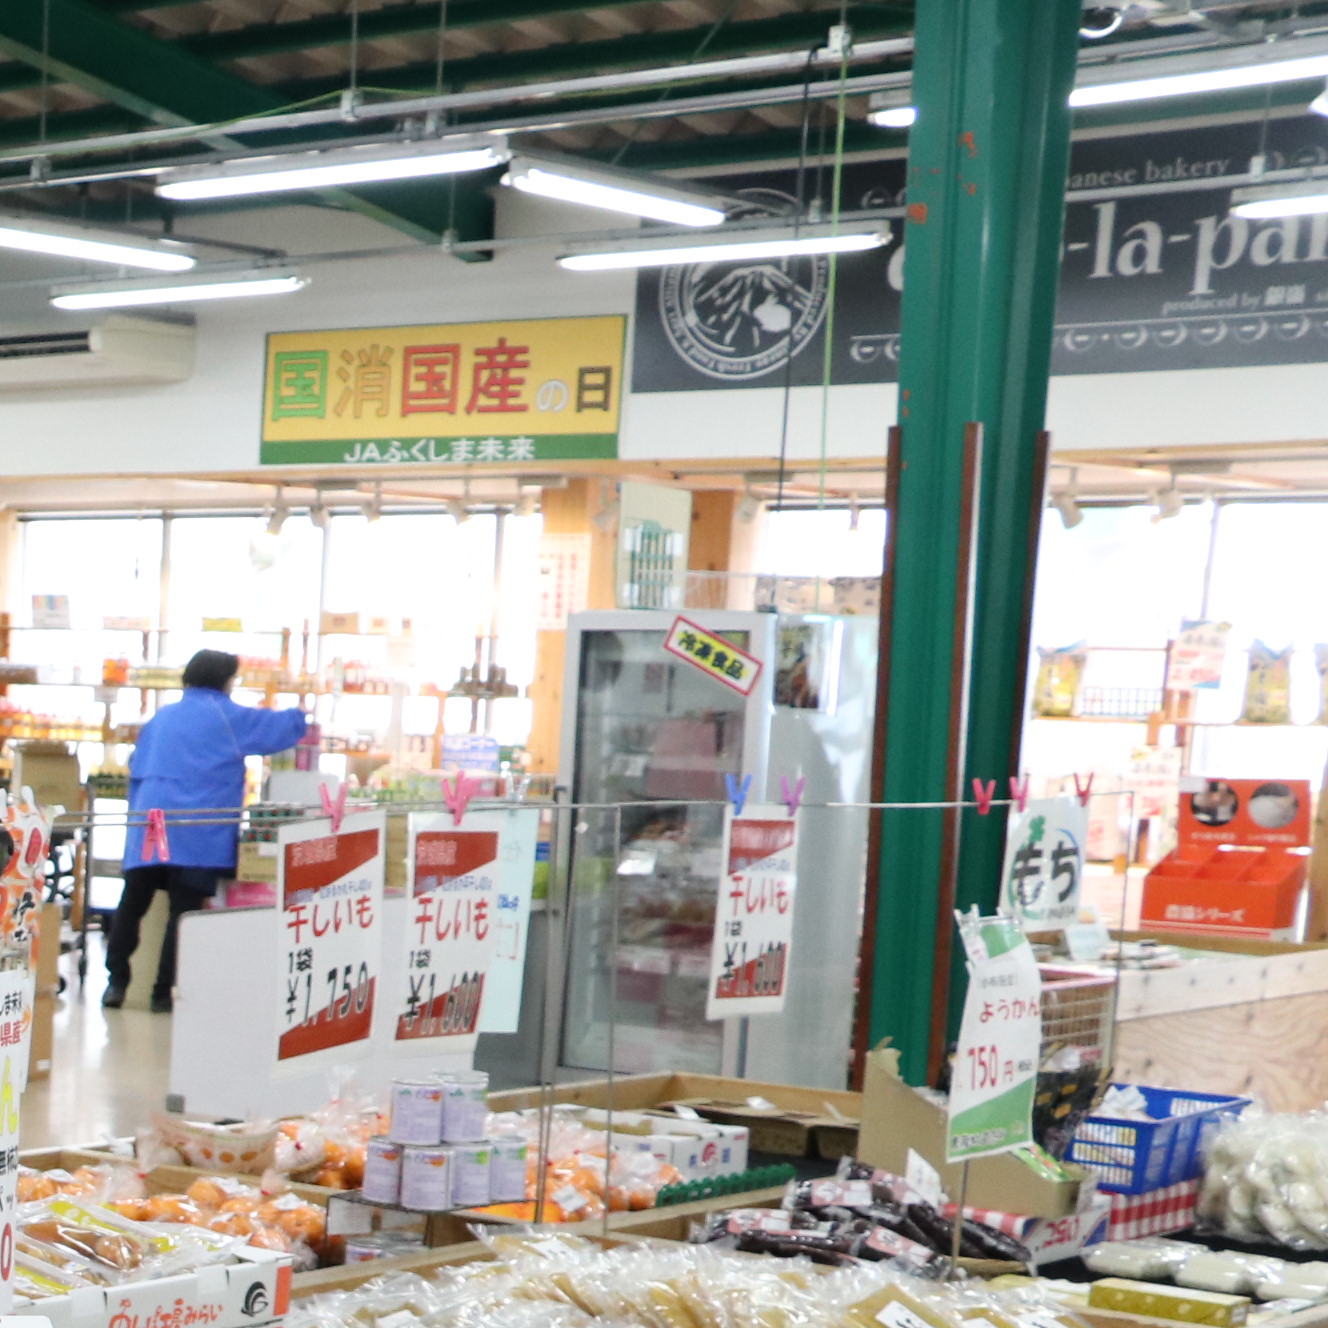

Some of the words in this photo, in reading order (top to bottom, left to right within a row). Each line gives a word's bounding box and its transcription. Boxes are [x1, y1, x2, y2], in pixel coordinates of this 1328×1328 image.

[1145, 157, 1232, 186] bakery
[1161, 297, 1237, 316] produced
[272, 337, 612, 421] 国消国産の日
[344, 436, 536, 463] JAふくしま未来
[1013, 839, 1080, 906] もち
[729, 875, 790, 917] 干しいも
[287, 895, 374, 944] 干しいも
[415, 896, 490, 944] 干しいも
